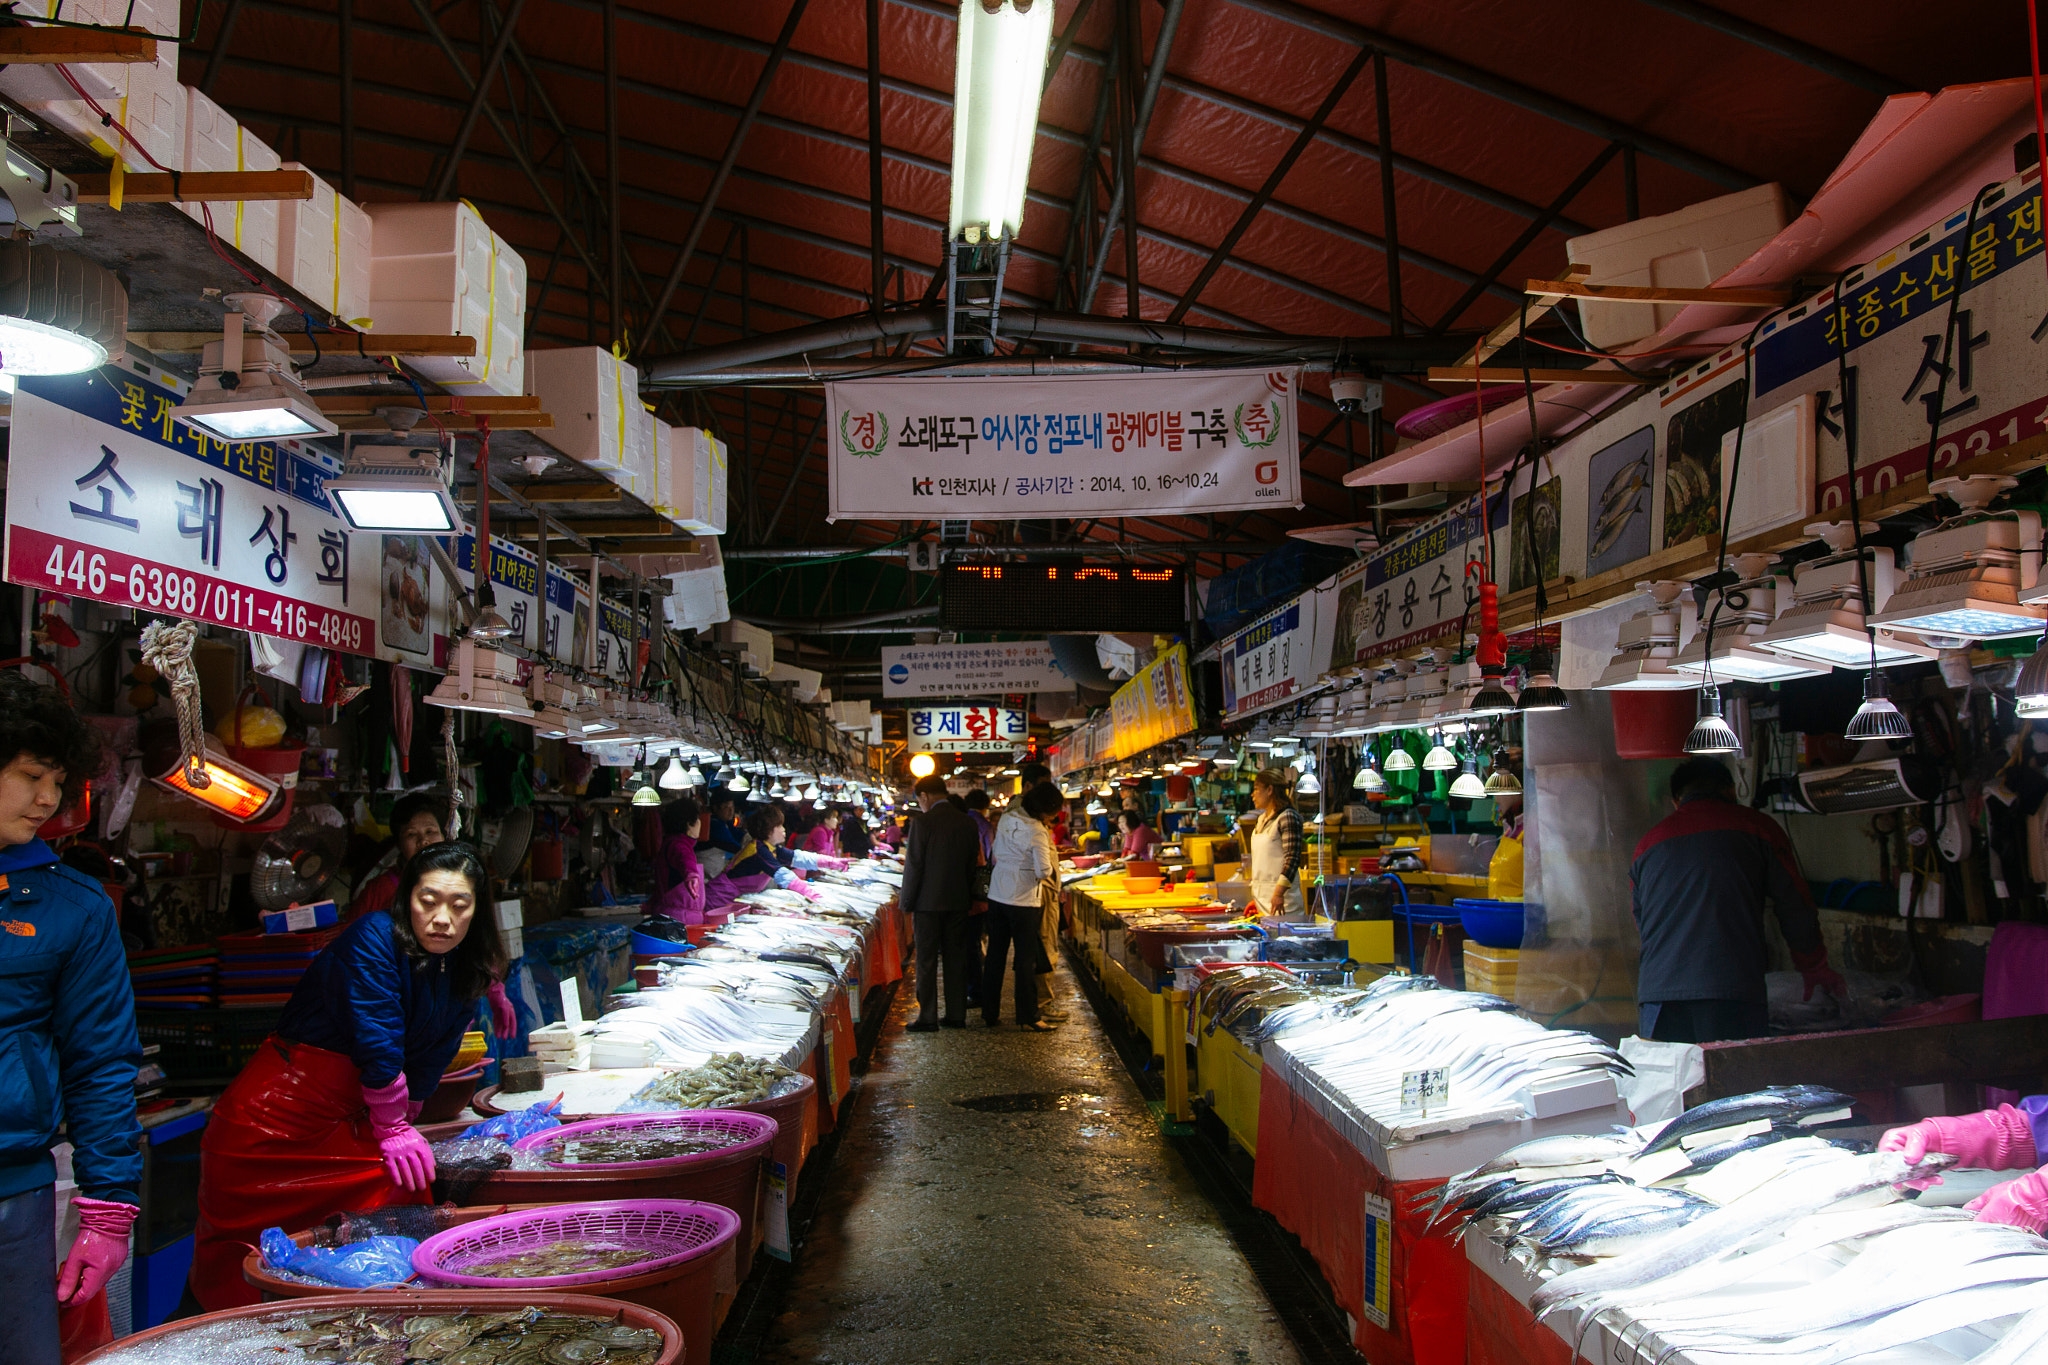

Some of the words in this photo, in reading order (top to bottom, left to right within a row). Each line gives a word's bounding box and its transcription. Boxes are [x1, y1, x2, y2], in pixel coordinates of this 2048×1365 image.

[1815, 309, 2048, 461] 서산
[852, 411, 876, 450] 경
[899, 416, 979, 455] 소래포구
[981, 413, 1041, 453] 어시장
[1043, 411, 1103, 454] 점포내
[1106, 410, 1185, 453] 광케이블
[1188, 408, 1229, 449] 구축
[1243, 403, 1271, 440] 축
[912, 477, 934, 496] kt
[938, 477, 996, 496] 인천지사
[1015, 476, 1074, 495] 공사기간
[1090, 475, 1126, 493] 2014.
[1132, 475, 1151, 493] 10.
[1157, 472, 1219, 491] 16~10.24
[1255, 487, 1281, 497] olleh
[69, 444, 350, 606] 소래상회
[470, 543, 536, 593] .대하전문
[1384, 527, 1447, 578] 각종수산물전문
[45, 544, 361, 650] 446-6398/011-416-4849
[900, 652, 926, 660] 소래포구
[1241, 637, 1290, 691] 대복회집
[1246, 685, 1284, 710] 441-6092
[910, 707, 1027, 740] 형제회집
[921, 741, 1015, 751] 441-2864
